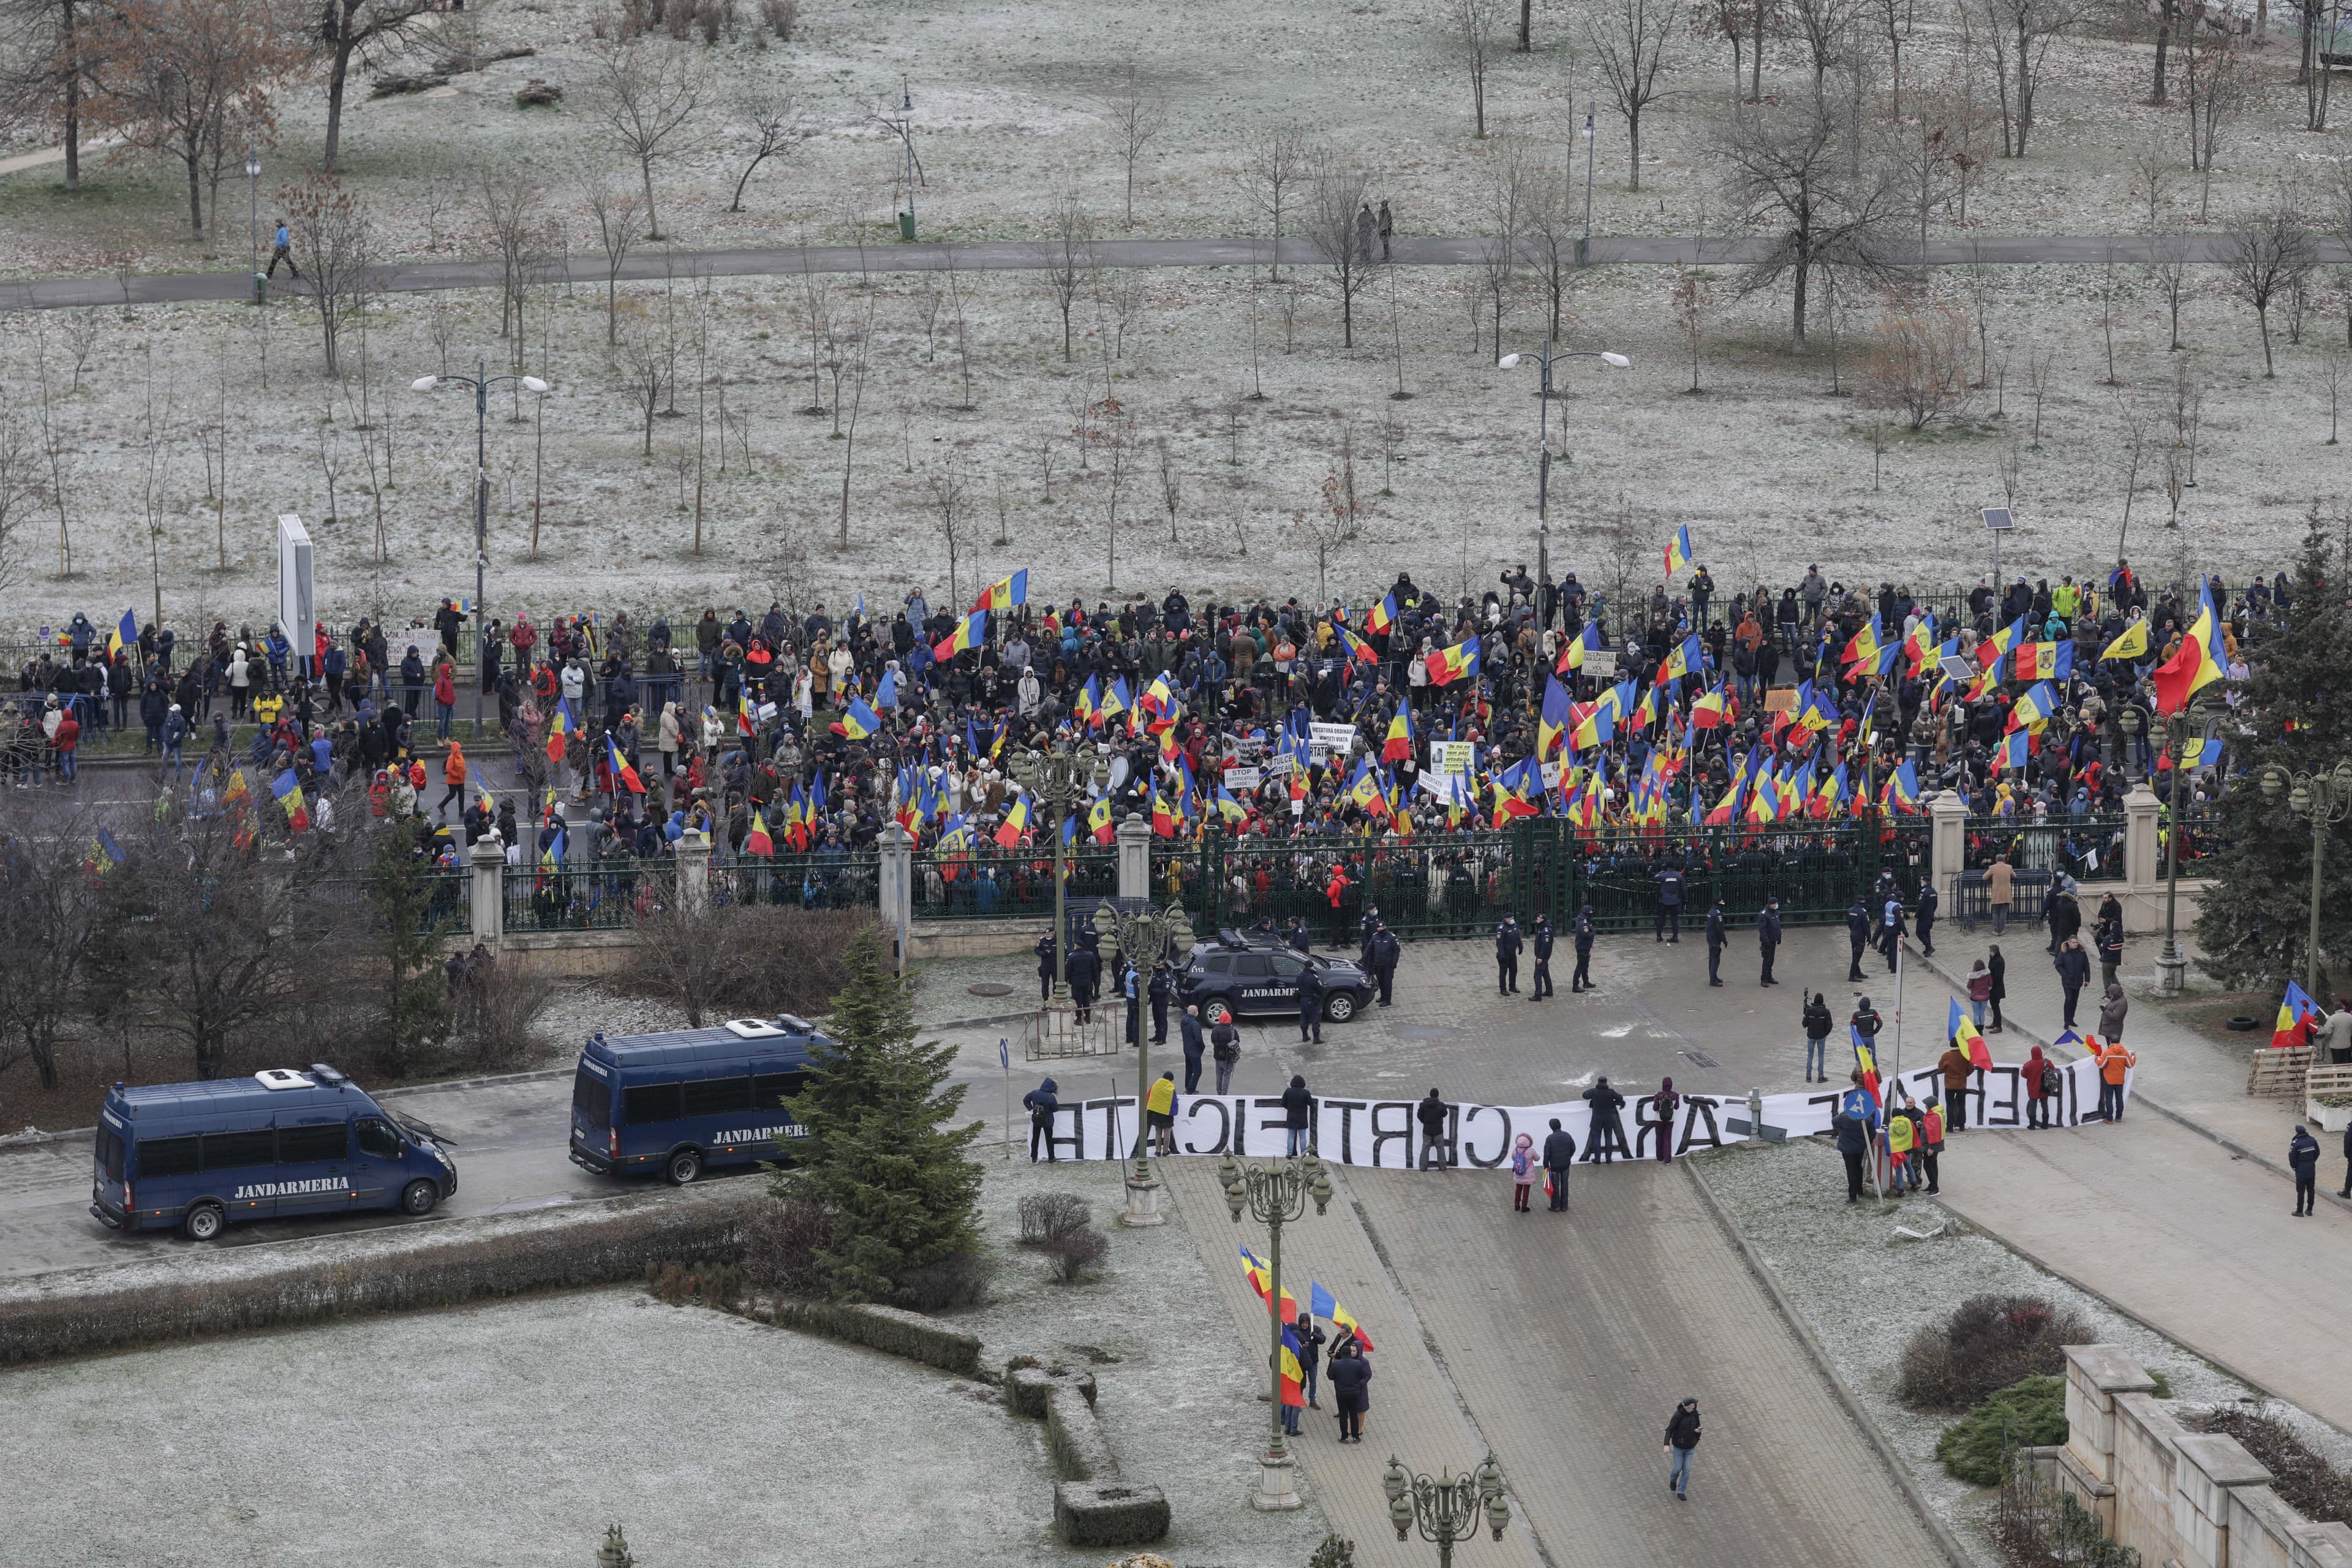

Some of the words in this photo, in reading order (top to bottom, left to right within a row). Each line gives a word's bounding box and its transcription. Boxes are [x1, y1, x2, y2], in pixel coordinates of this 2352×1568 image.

[1273, 755, 1292, 765] TULCE
[1422, 771, 1443, 788] LIBERTATE
[235, 1176, 350, 1199] JANDARMERIA
